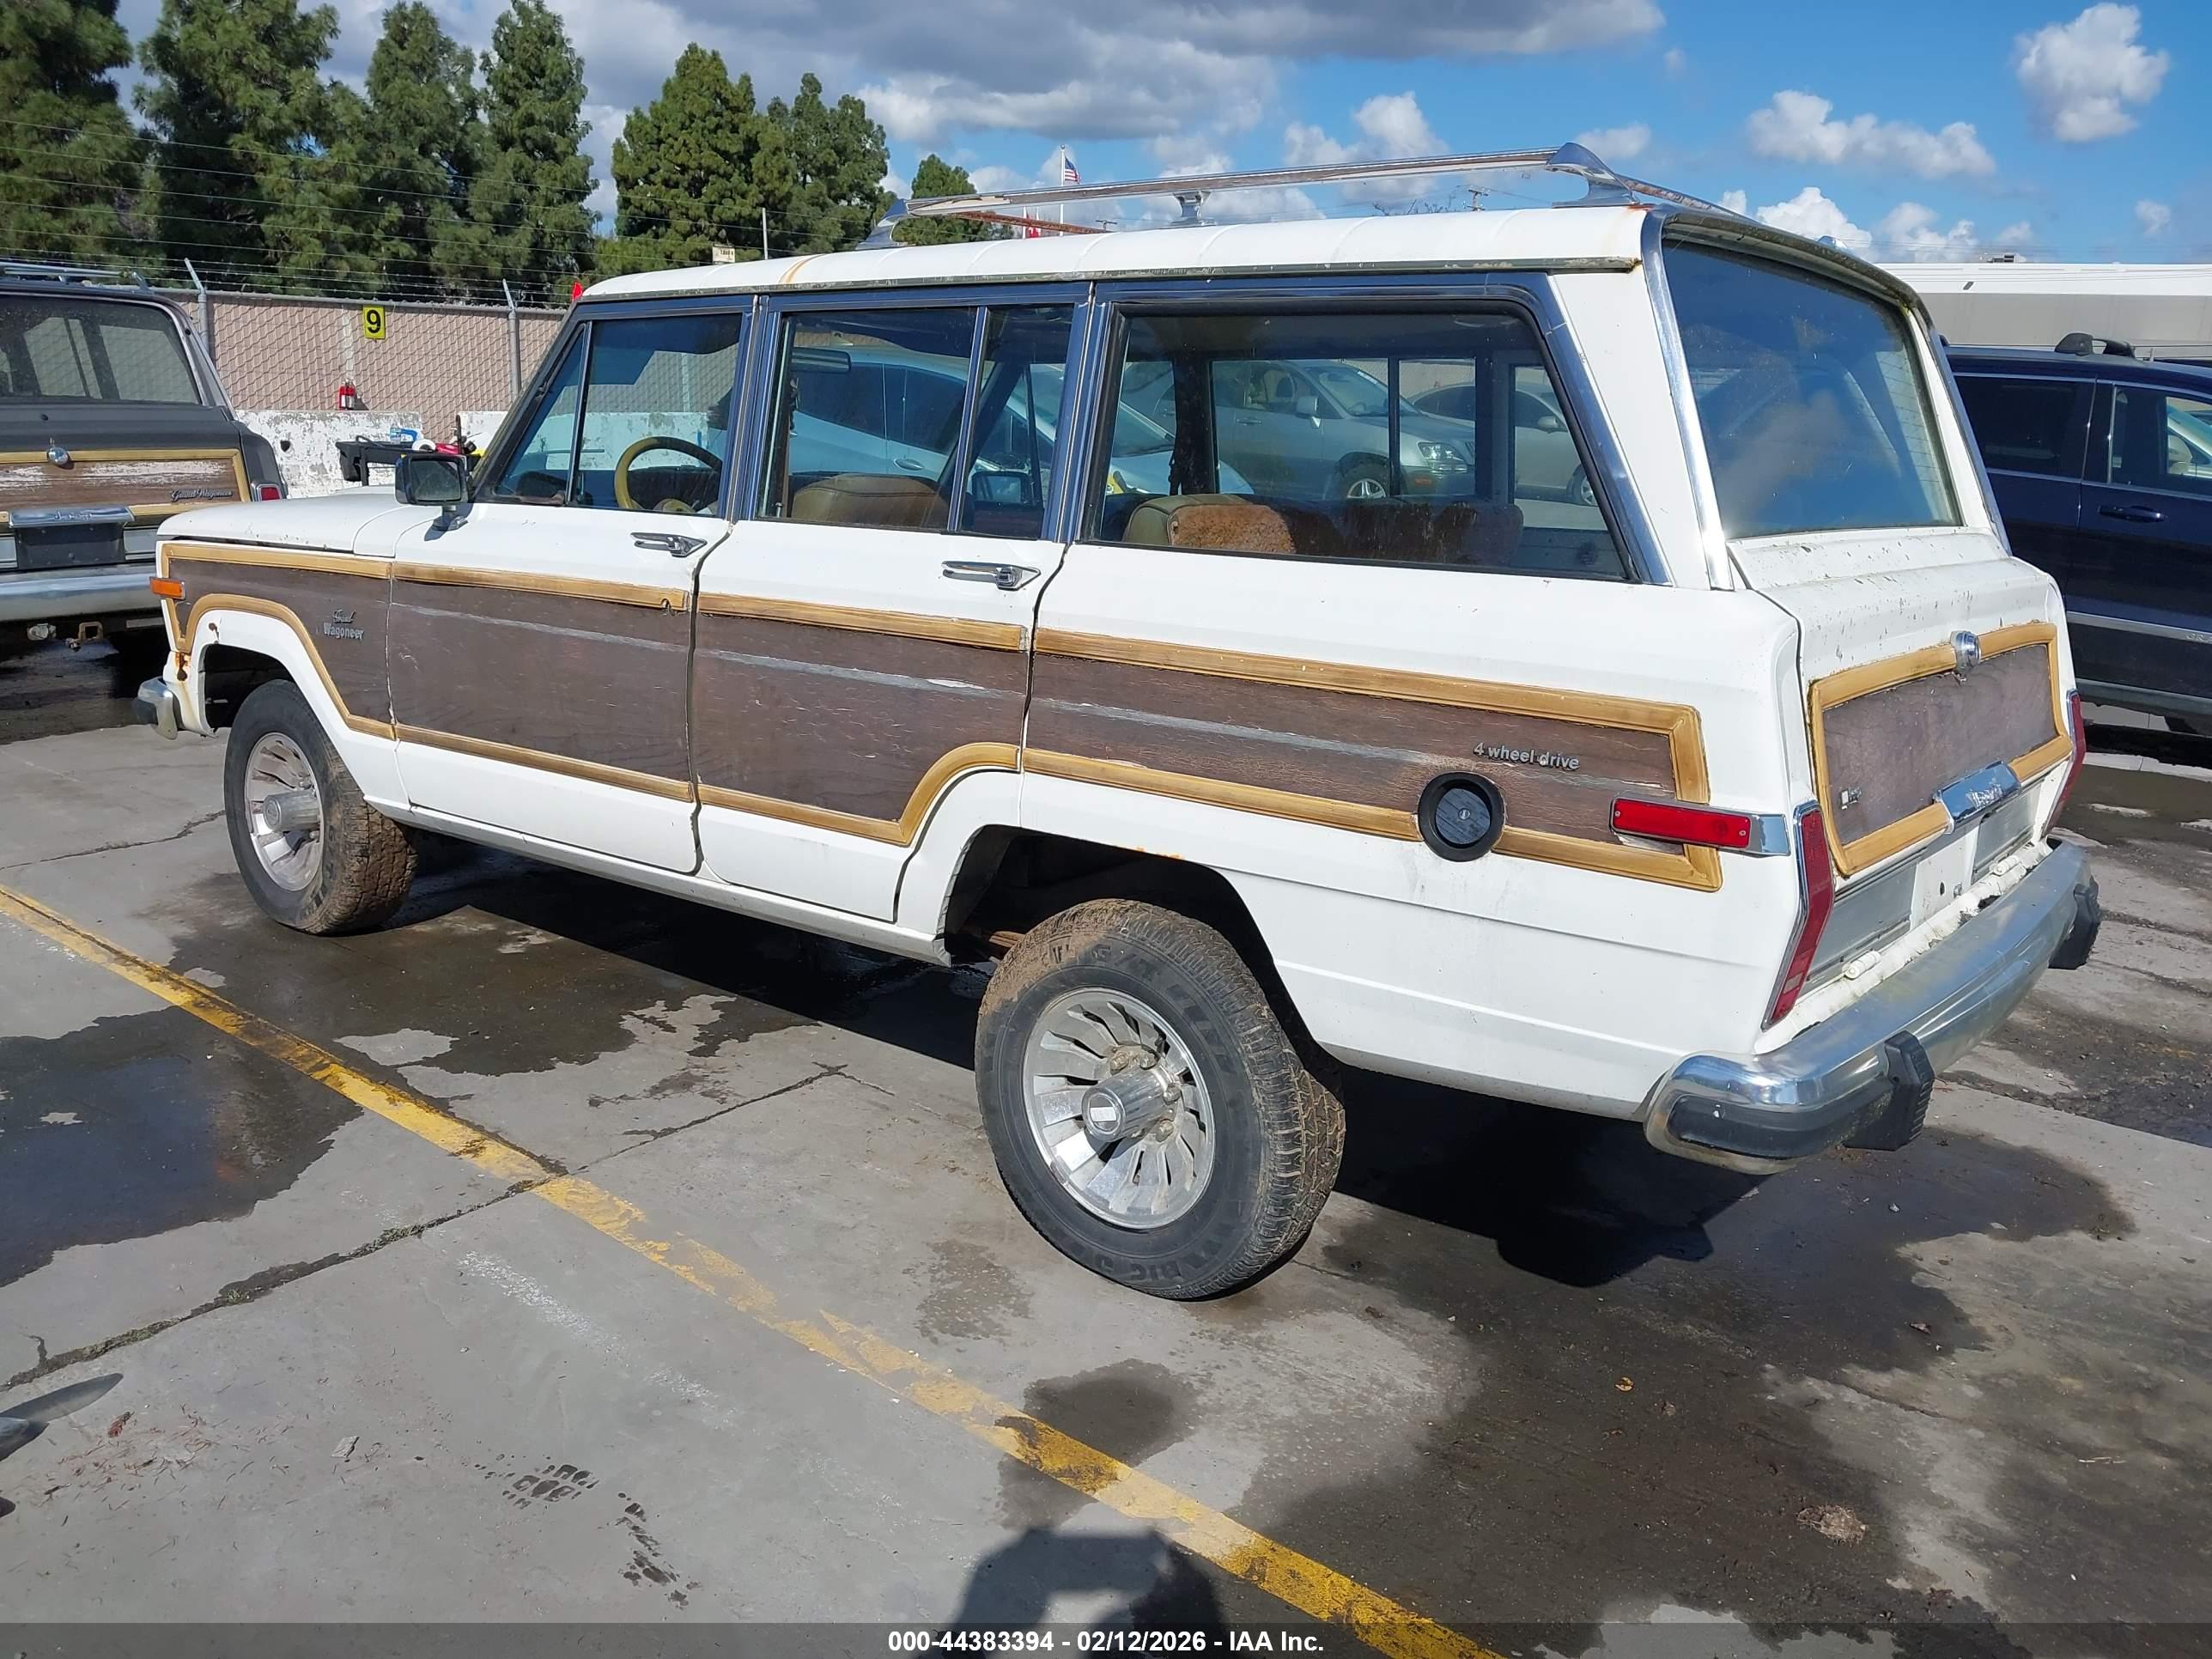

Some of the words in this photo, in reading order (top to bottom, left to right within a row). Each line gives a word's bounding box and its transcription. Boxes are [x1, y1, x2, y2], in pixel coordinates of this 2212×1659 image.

[367, 309, 381, 334] 9
[323, 622, 364, 640] Wagoneer
[1474, 742, 1485, 756] 4
[1487, 745, 1534, 764] wheel
[1538, 751, 1579, 770] drive
